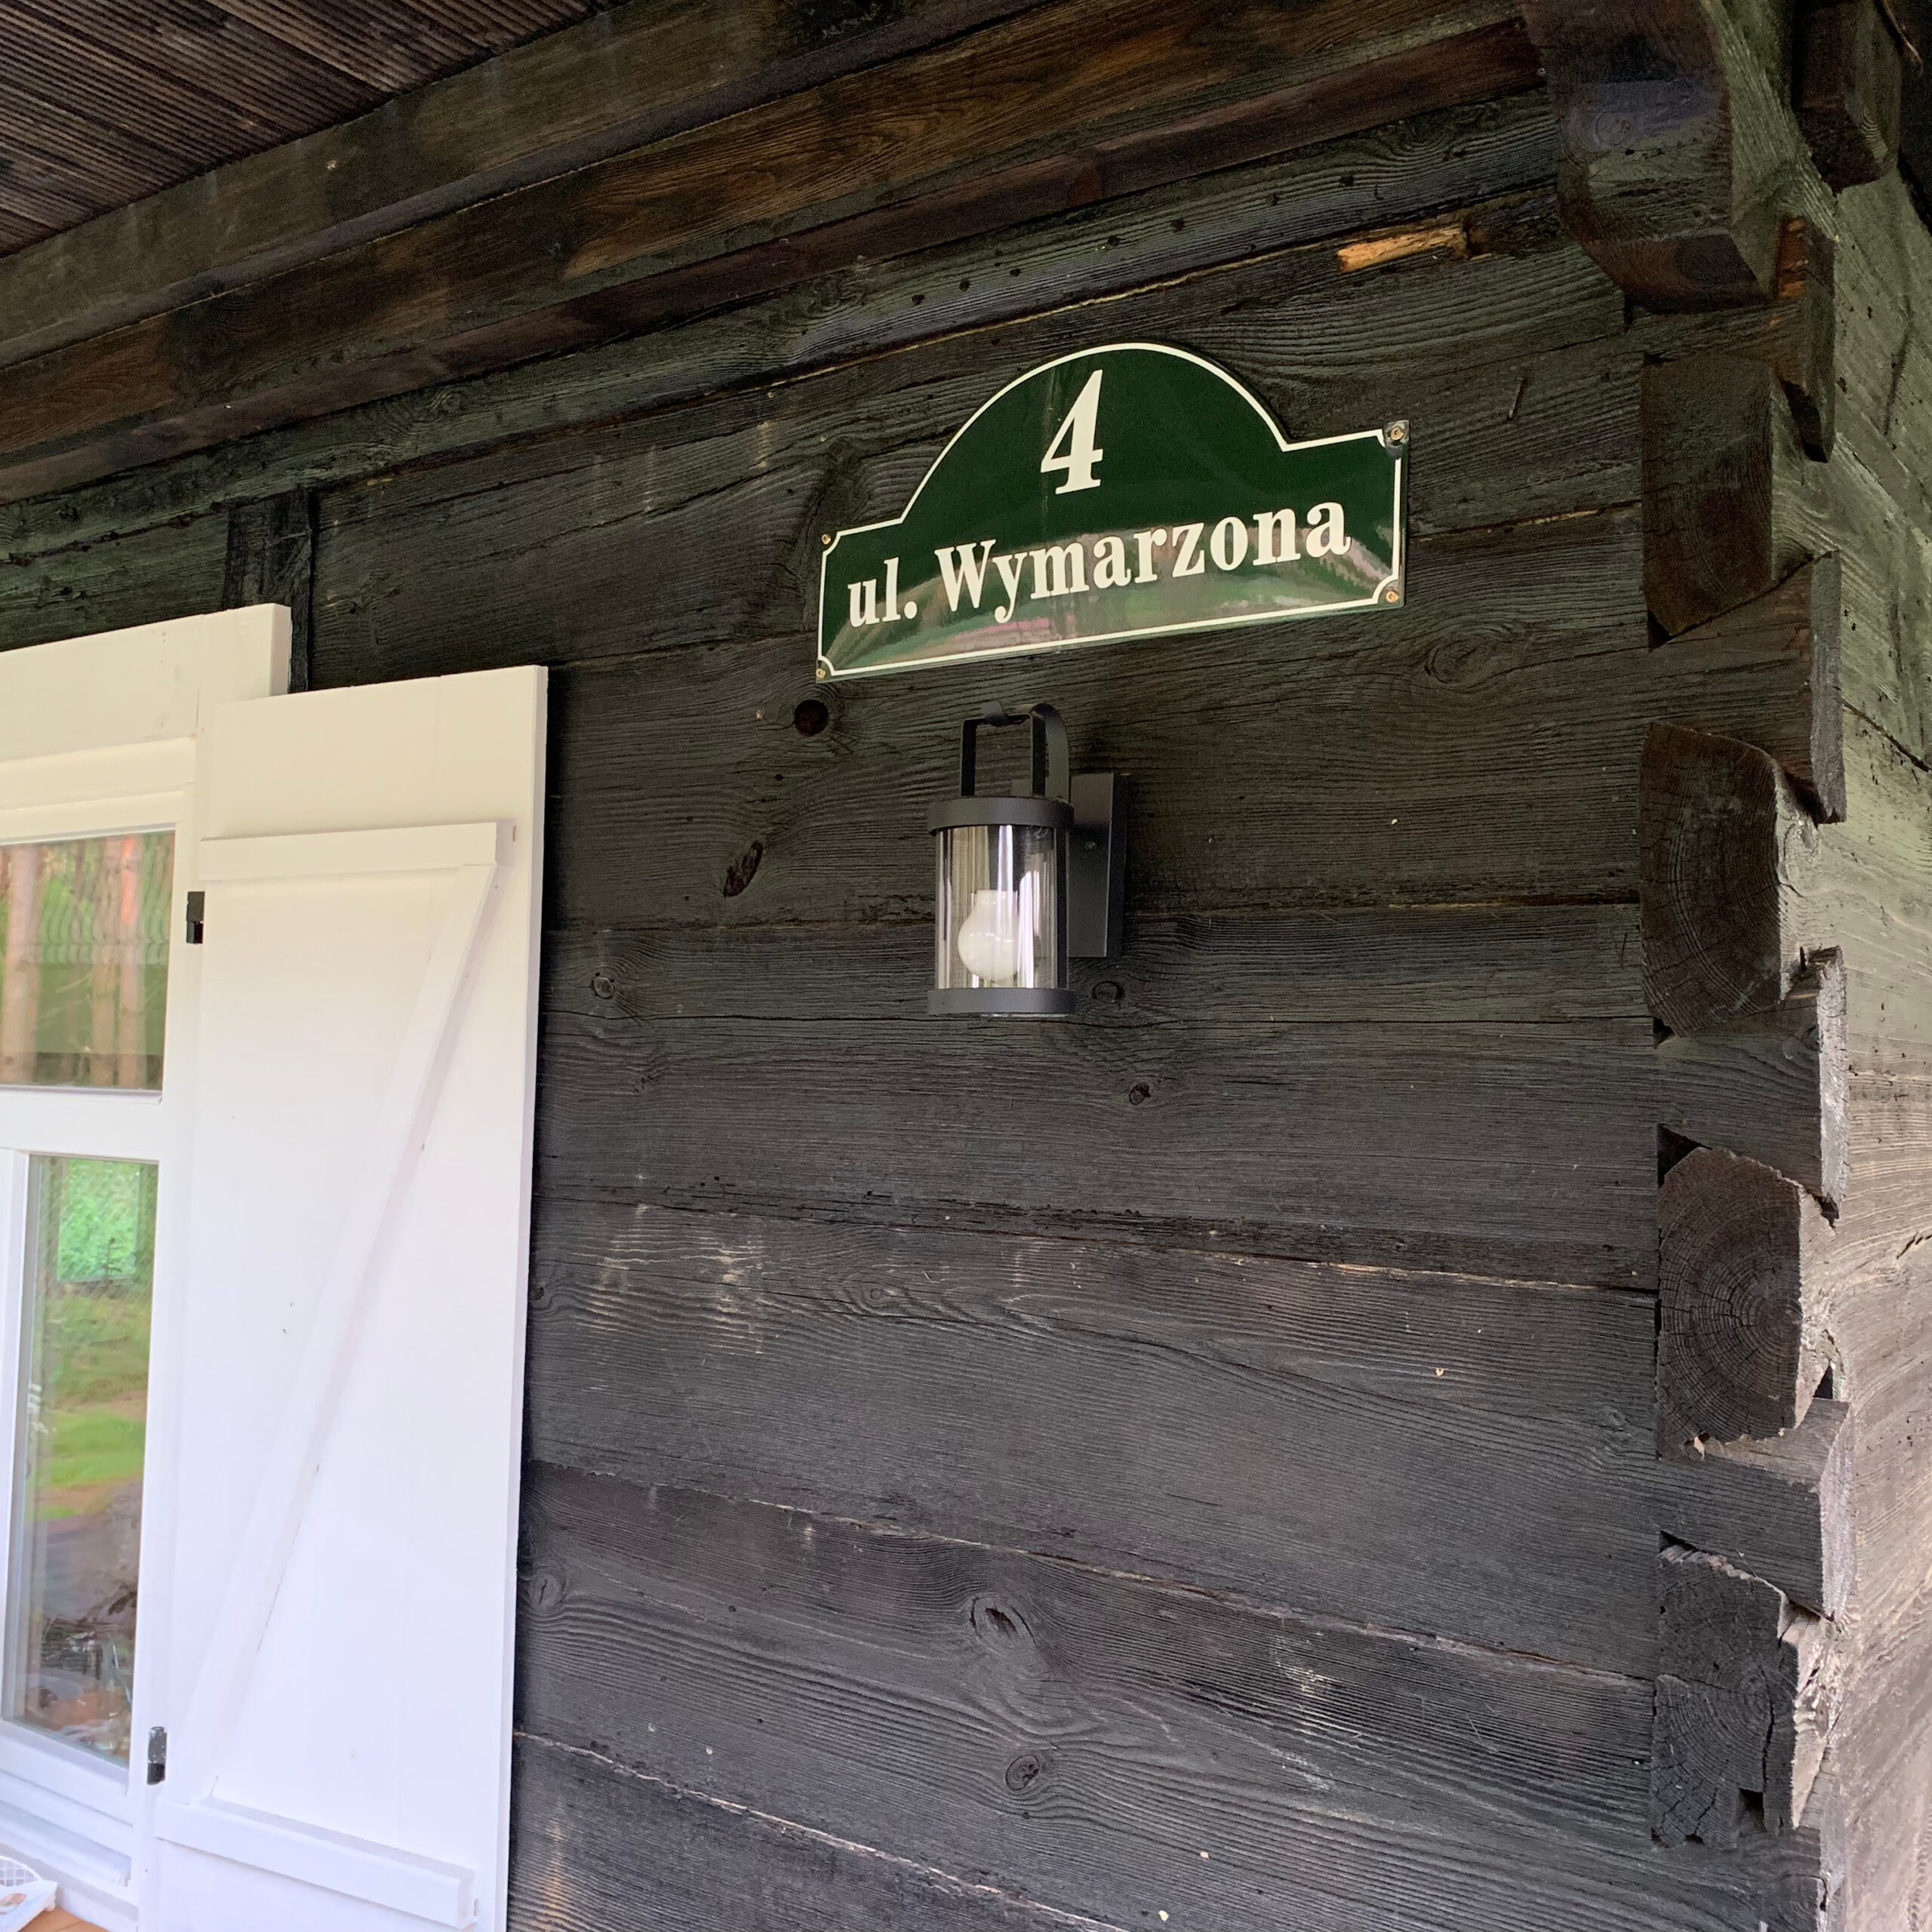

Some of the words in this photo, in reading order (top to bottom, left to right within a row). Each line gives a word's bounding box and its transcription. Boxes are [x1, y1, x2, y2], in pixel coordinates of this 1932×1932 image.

[1041, 369, 1103, 495] 4
[847, 557, 918, 628] ul.
[934, 501, 1352, 623] Wymarzona
